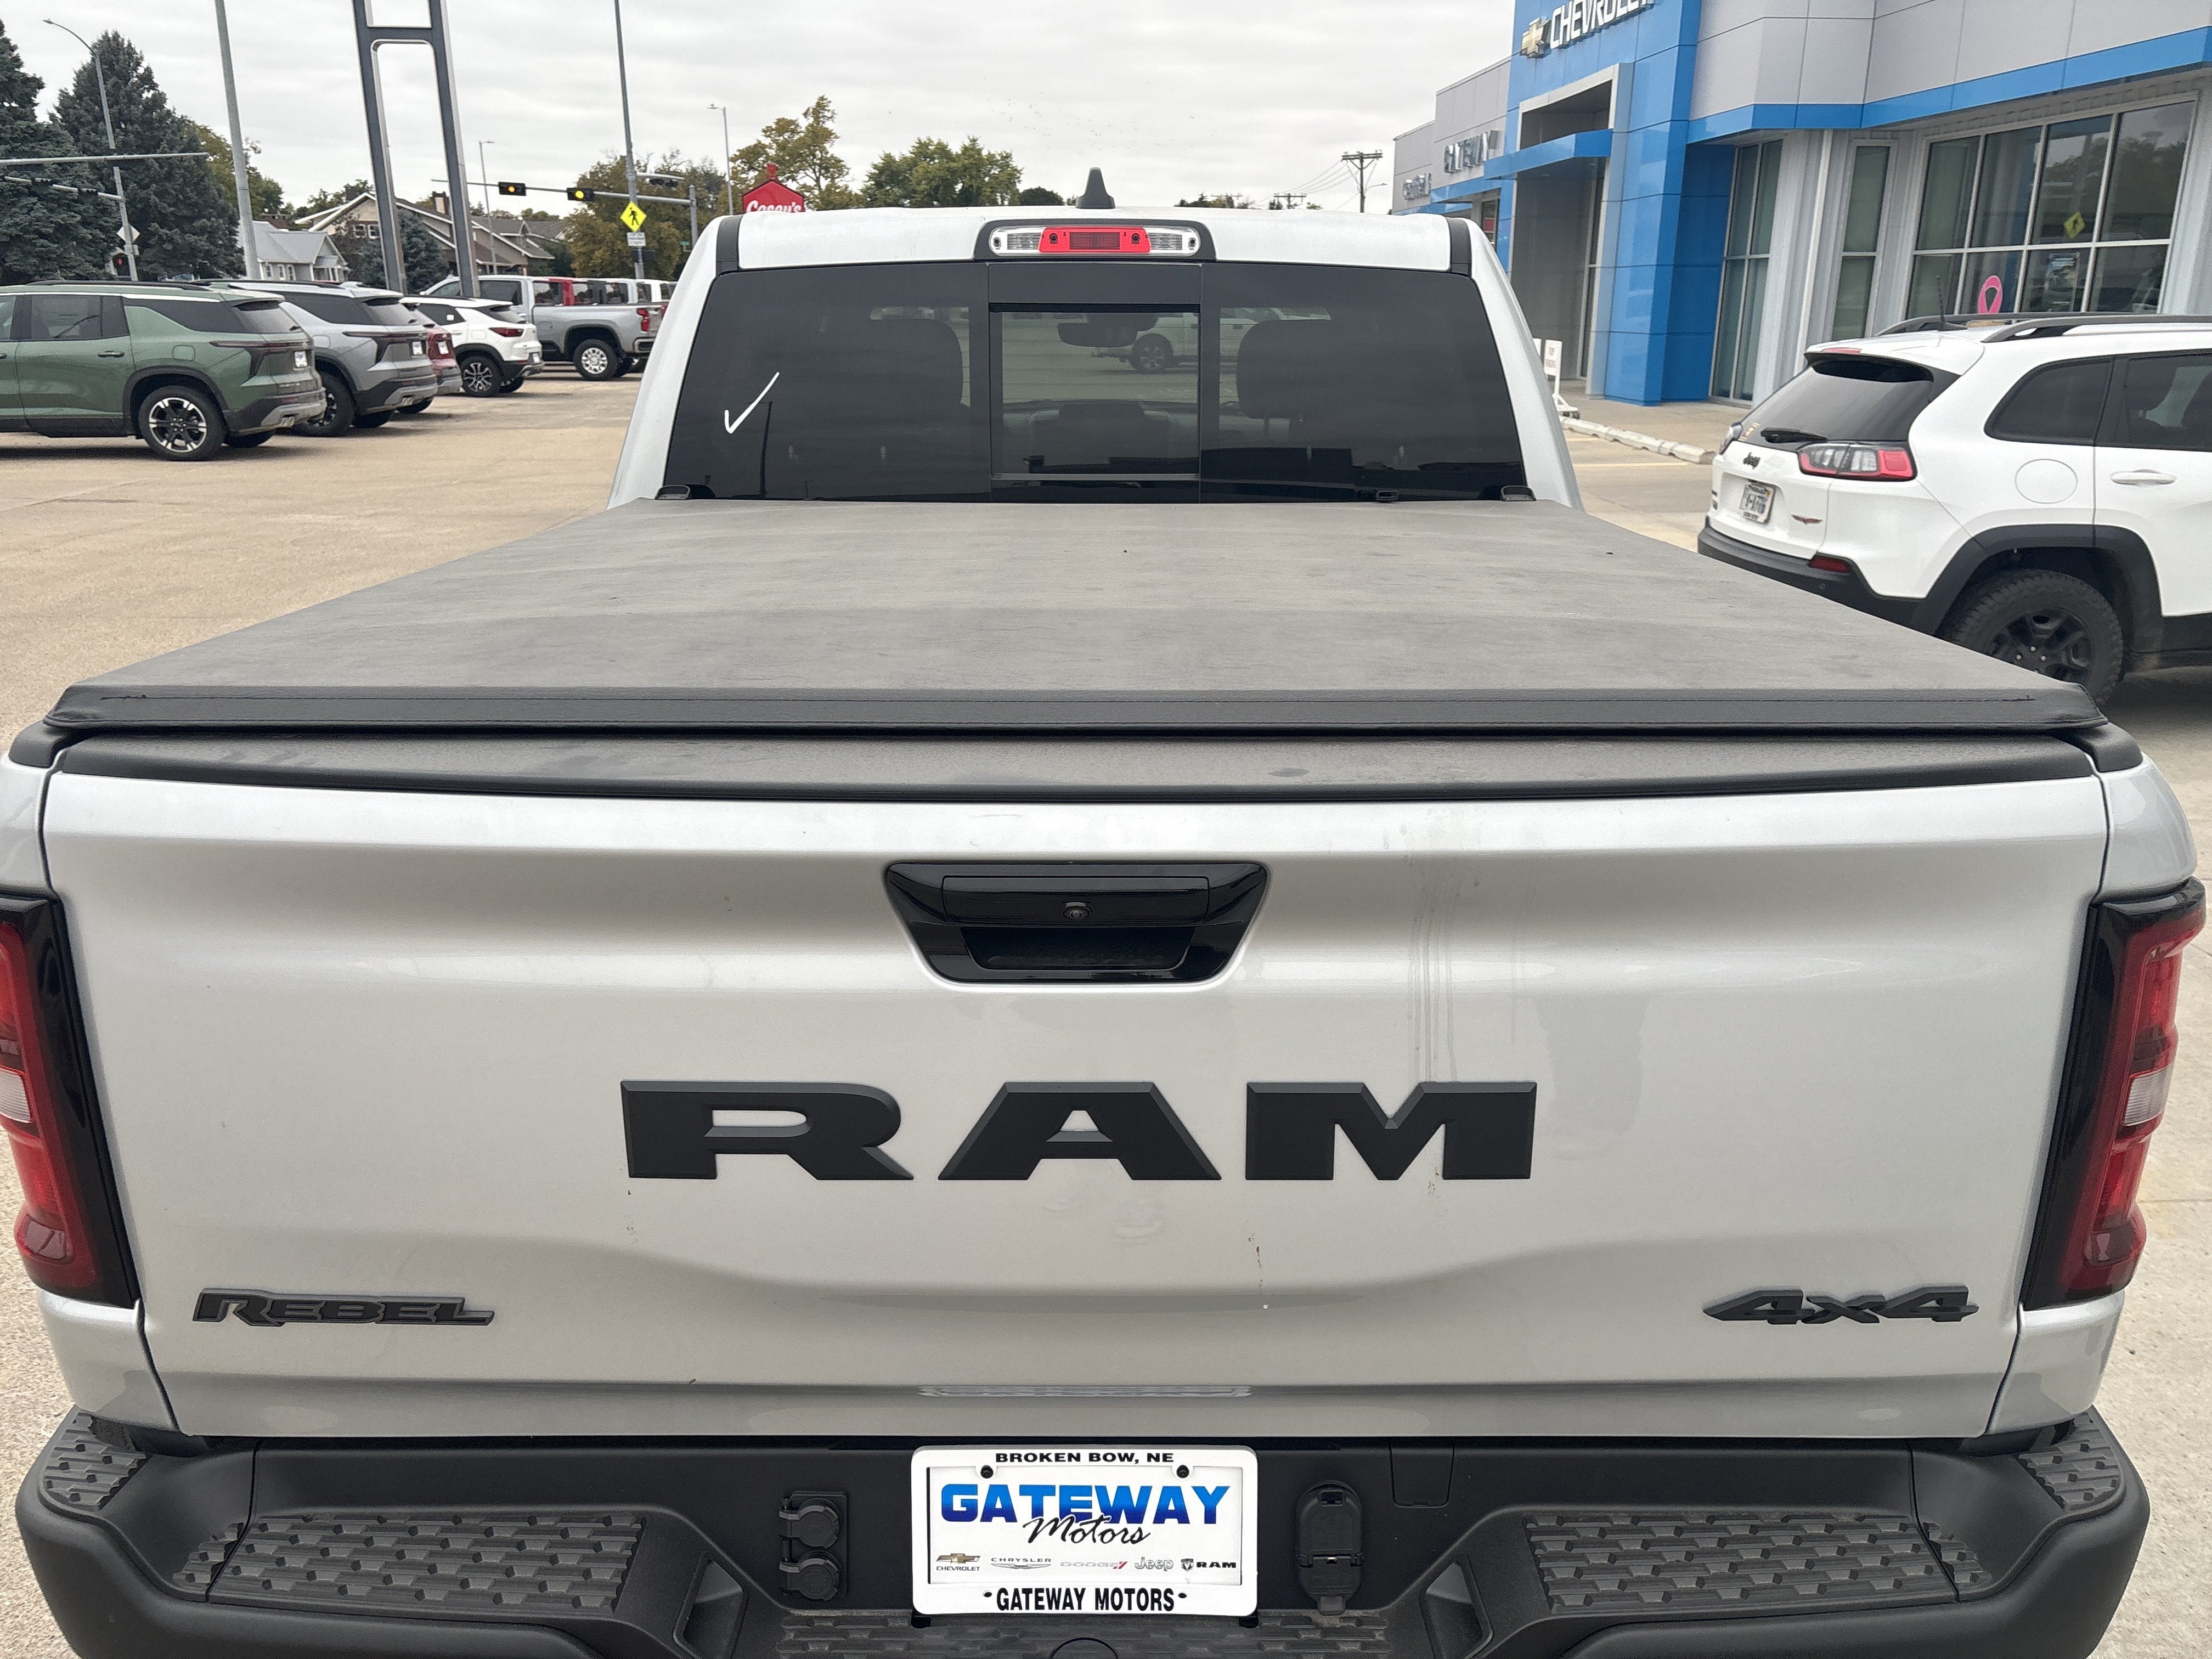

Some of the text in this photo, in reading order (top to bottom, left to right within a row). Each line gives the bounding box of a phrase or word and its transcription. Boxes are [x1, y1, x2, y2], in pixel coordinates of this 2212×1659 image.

[1549, 0, 1654, 49] CHEVRO
[620, 1080, 1537, 1181] RAM
[193, 1288, 495, 1328] REBEL
[995, 1452, 1174, 1464] BROKEN BOW, NE
[941, 1483, 1231, 1524] GATEWAY
[1022, 1514, 1151, 1544] Motors
[1134, 1556, 1174, 1572] Jeep
[996, 1587, 1175, 1612] GATEWAY MOTORS
